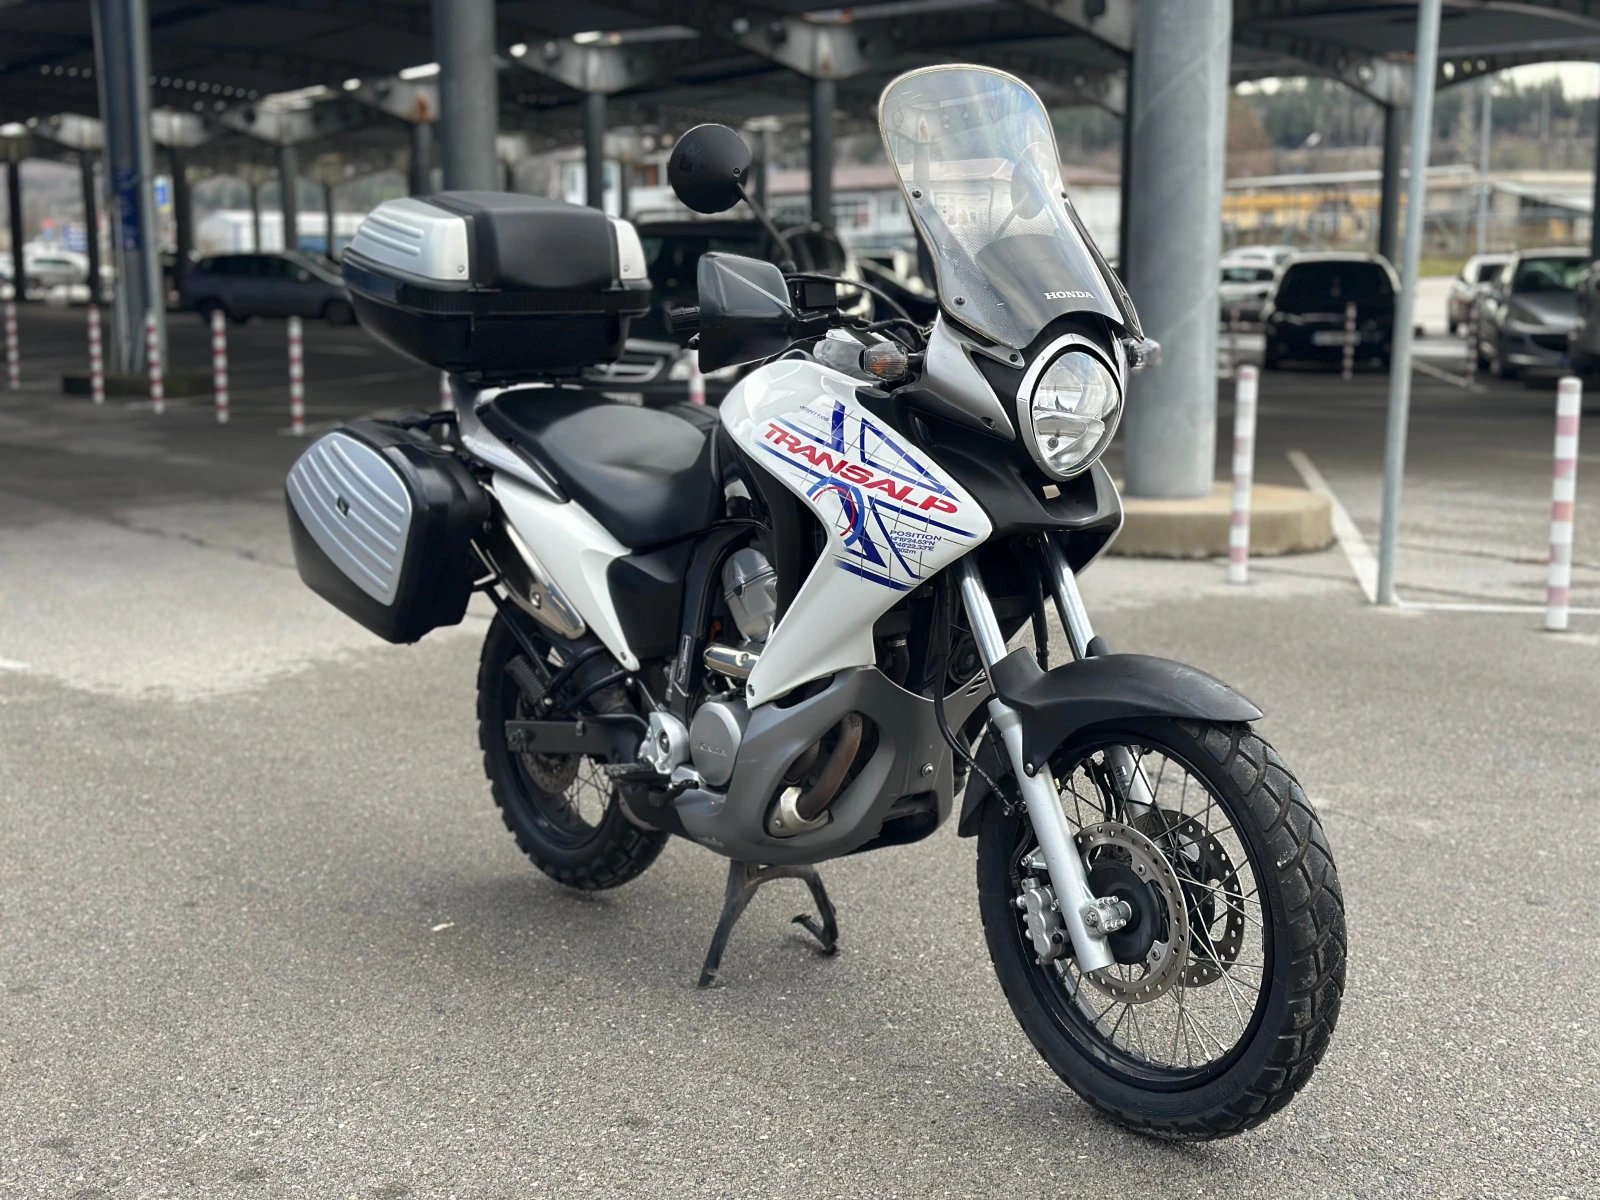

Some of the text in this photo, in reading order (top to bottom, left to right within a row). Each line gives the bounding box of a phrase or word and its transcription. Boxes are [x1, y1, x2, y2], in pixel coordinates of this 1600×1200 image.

[1043, 290, 1096, 300] HONDA
[764, 422, 958, 514] TRANSALP
[890, 530, 942, 541] POSITION
